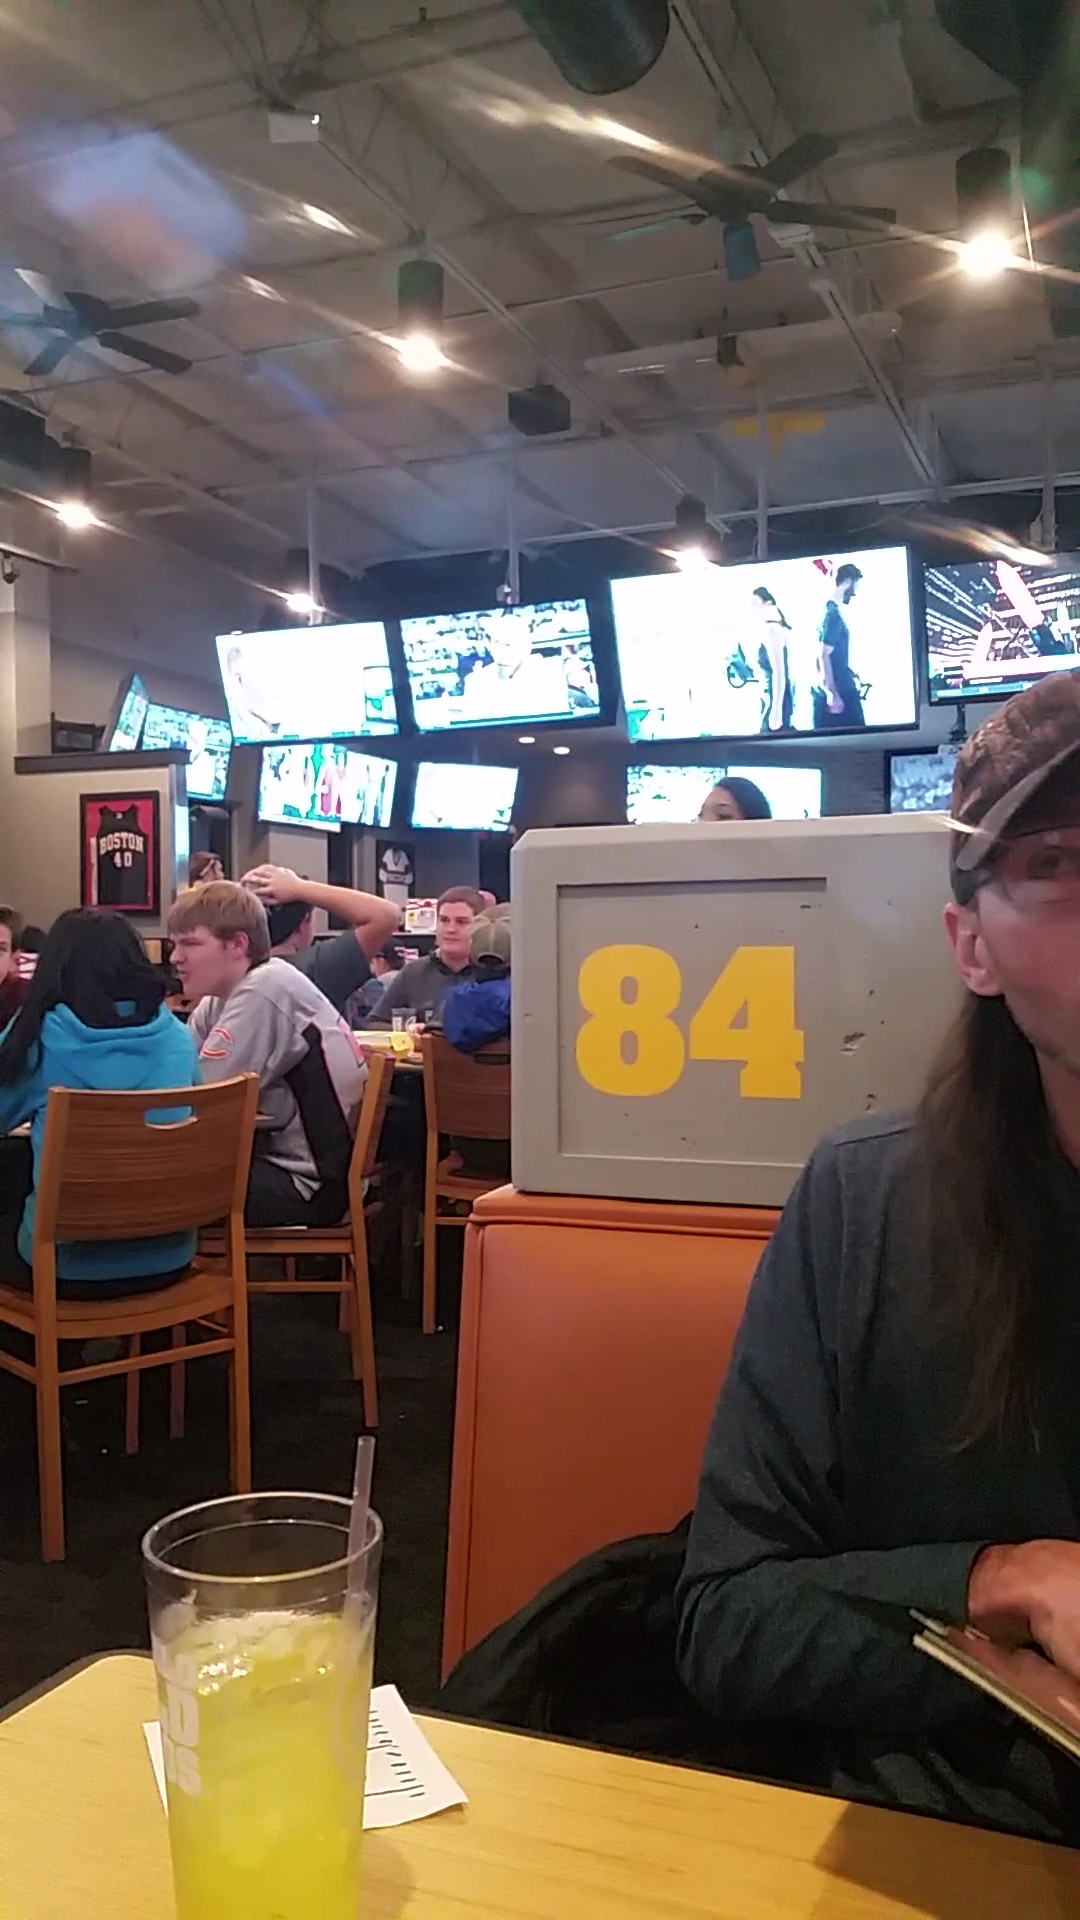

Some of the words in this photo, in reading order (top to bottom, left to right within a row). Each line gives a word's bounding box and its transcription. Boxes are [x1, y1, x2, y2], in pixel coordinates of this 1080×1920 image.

[99, 832, 144, 855] BOSTON
[113, 851, 133, 868] 40
[576, 944, 804, 1099] 84
